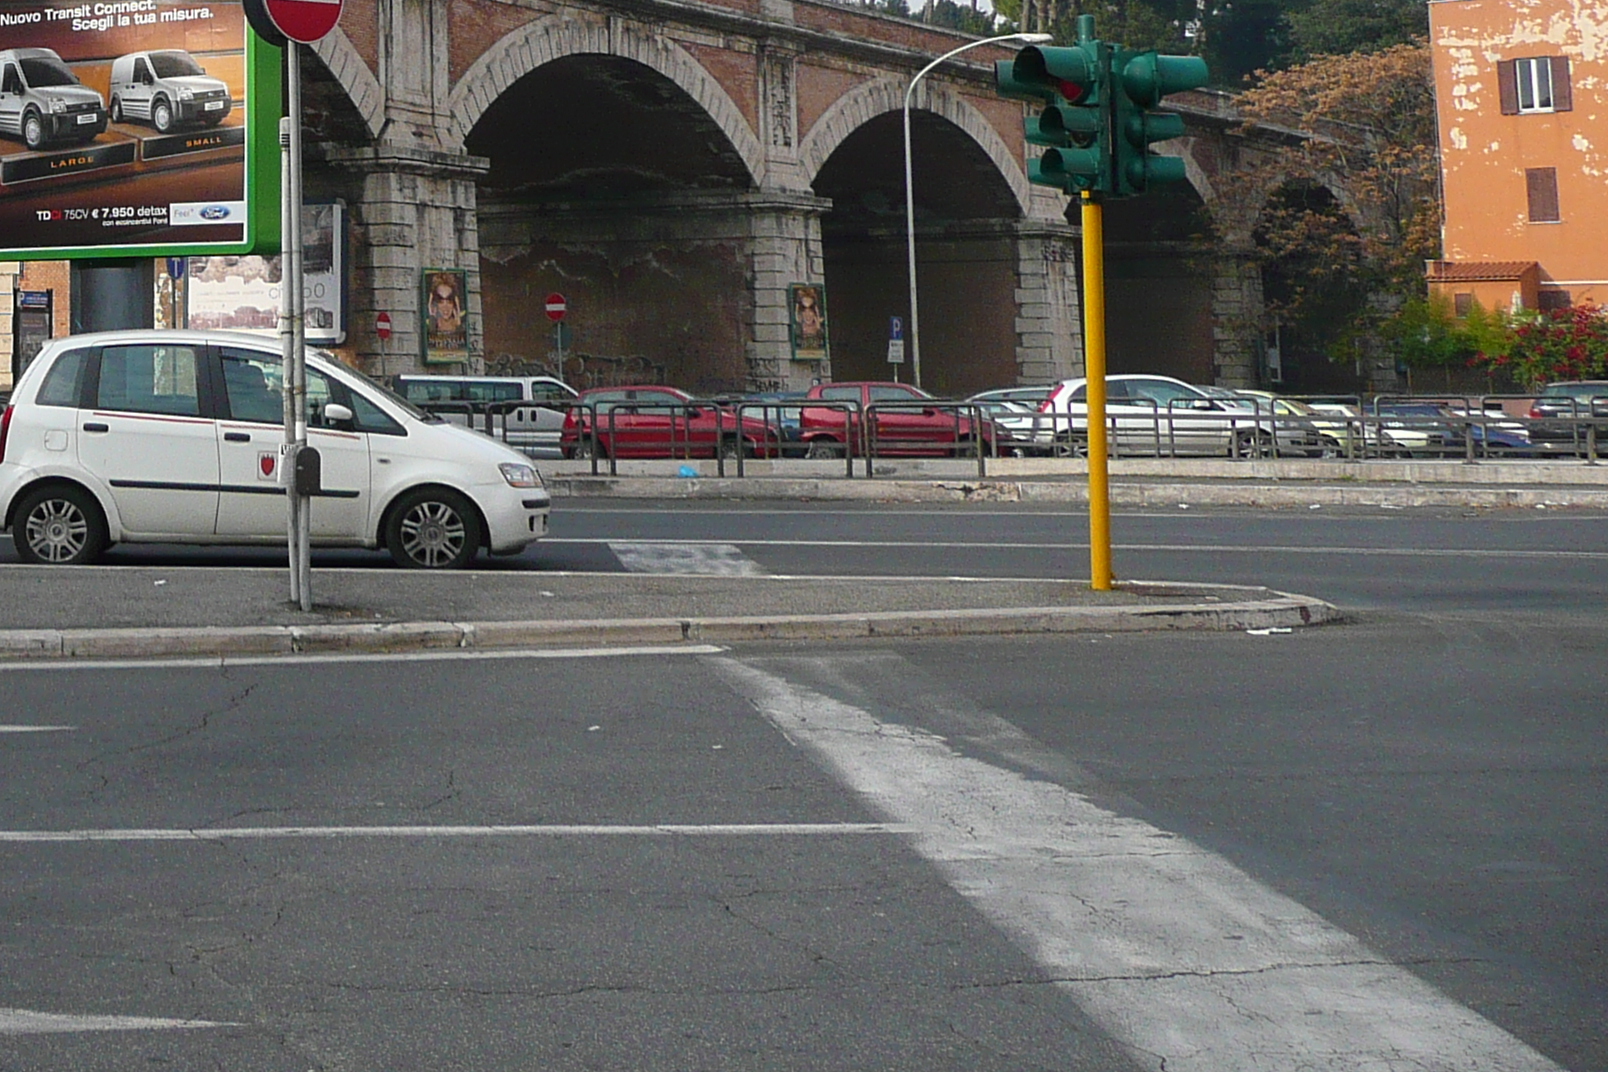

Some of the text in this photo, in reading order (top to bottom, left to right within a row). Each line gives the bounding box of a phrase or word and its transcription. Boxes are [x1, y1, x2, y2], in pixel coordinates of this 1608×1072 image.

[0, 11, 41, 26] Nuovo
[45, 4, 91, 21] Transit
[72, 6, 214, 32] Scegli la tua misura.
[185, 136, 222, 148] SMALL
[64, 208, 89, 221] 75CV
[91, 208, 99, 219] €
[101, 206, 135, 219] 7.950
[137, 205, 168, 218] detax
[893, 318, 901, 338] P
